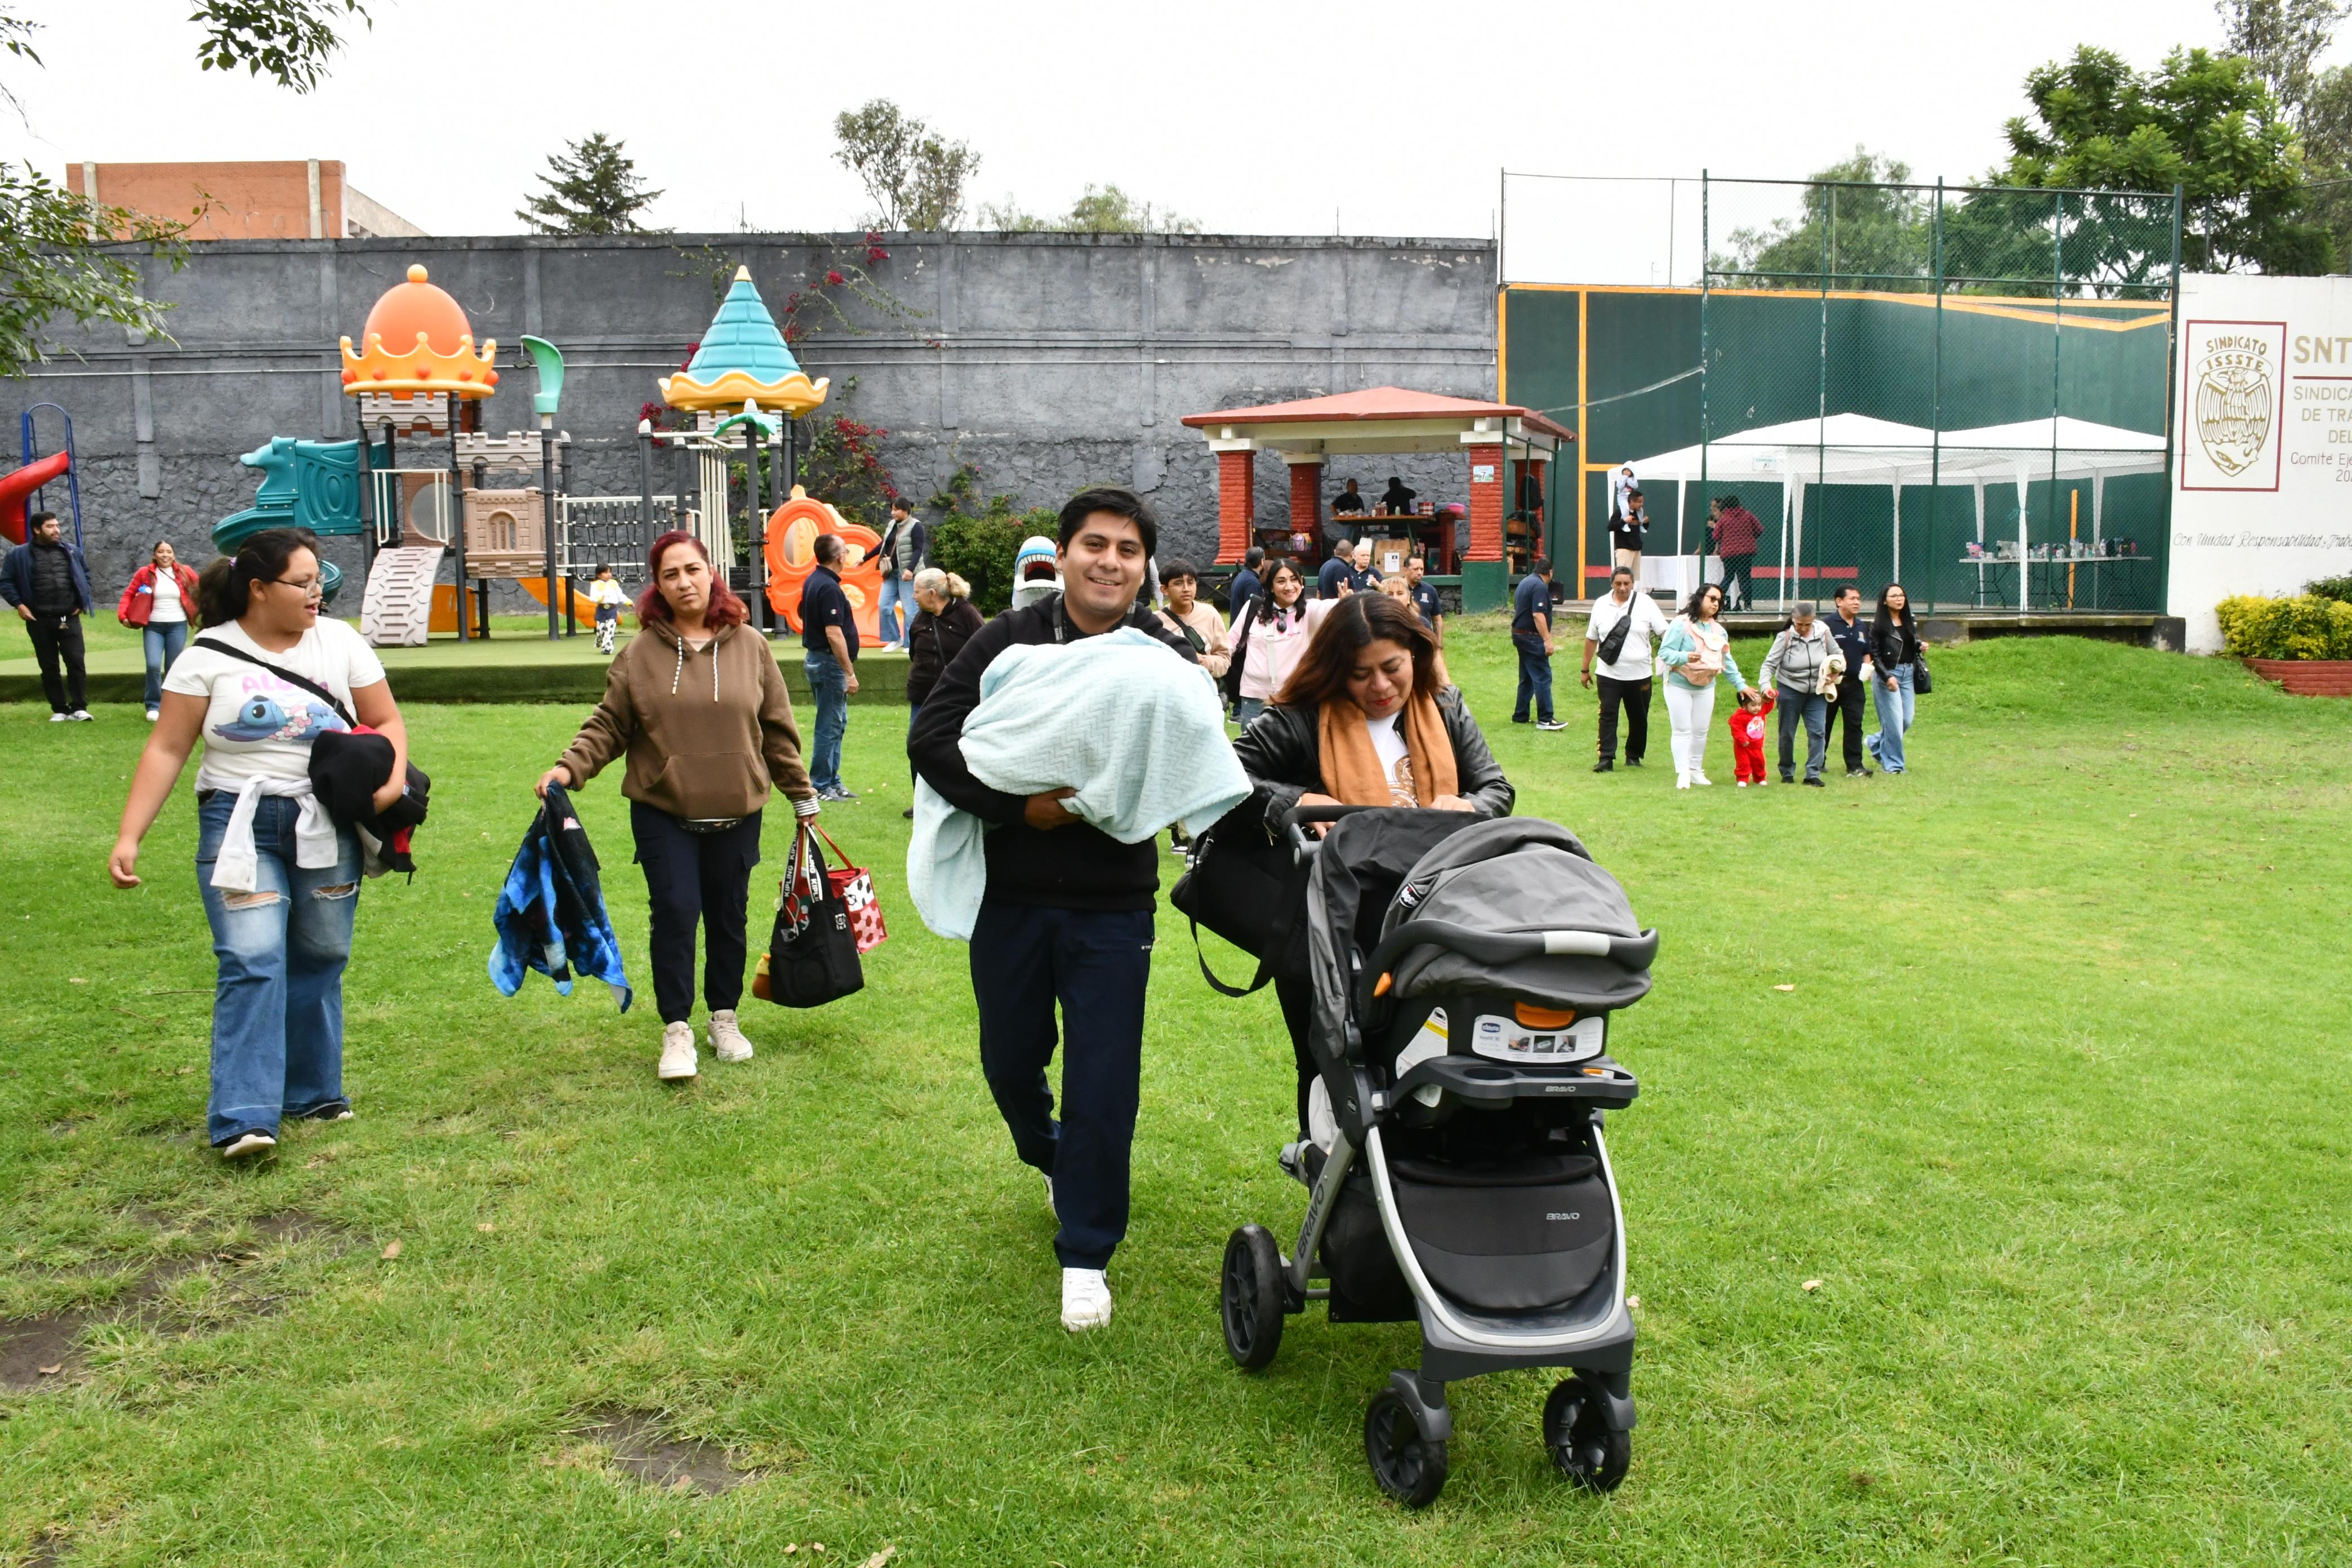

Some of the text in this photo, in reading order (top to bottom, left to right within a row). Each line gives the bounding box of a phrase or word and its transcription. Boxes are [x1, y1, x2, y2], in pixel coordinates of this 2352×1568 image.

[2206, 336, 2267, 355] SINDICATO
[2207, 354, 2264, 372] ISSSTE
[2302, 408, 2321, 421] DE
[2291, 452, 2333, 465] Comité
[1481, 471, 1487, 480] 7
[2173, 533, 2193, 546] Con
[242, 674, 329, 694] ALO
[783, 865, 794, 897] KIPLING
[810, 879, 819, 902] KIPLI
[1298, 1183, 1324, 1259] BRAVO
